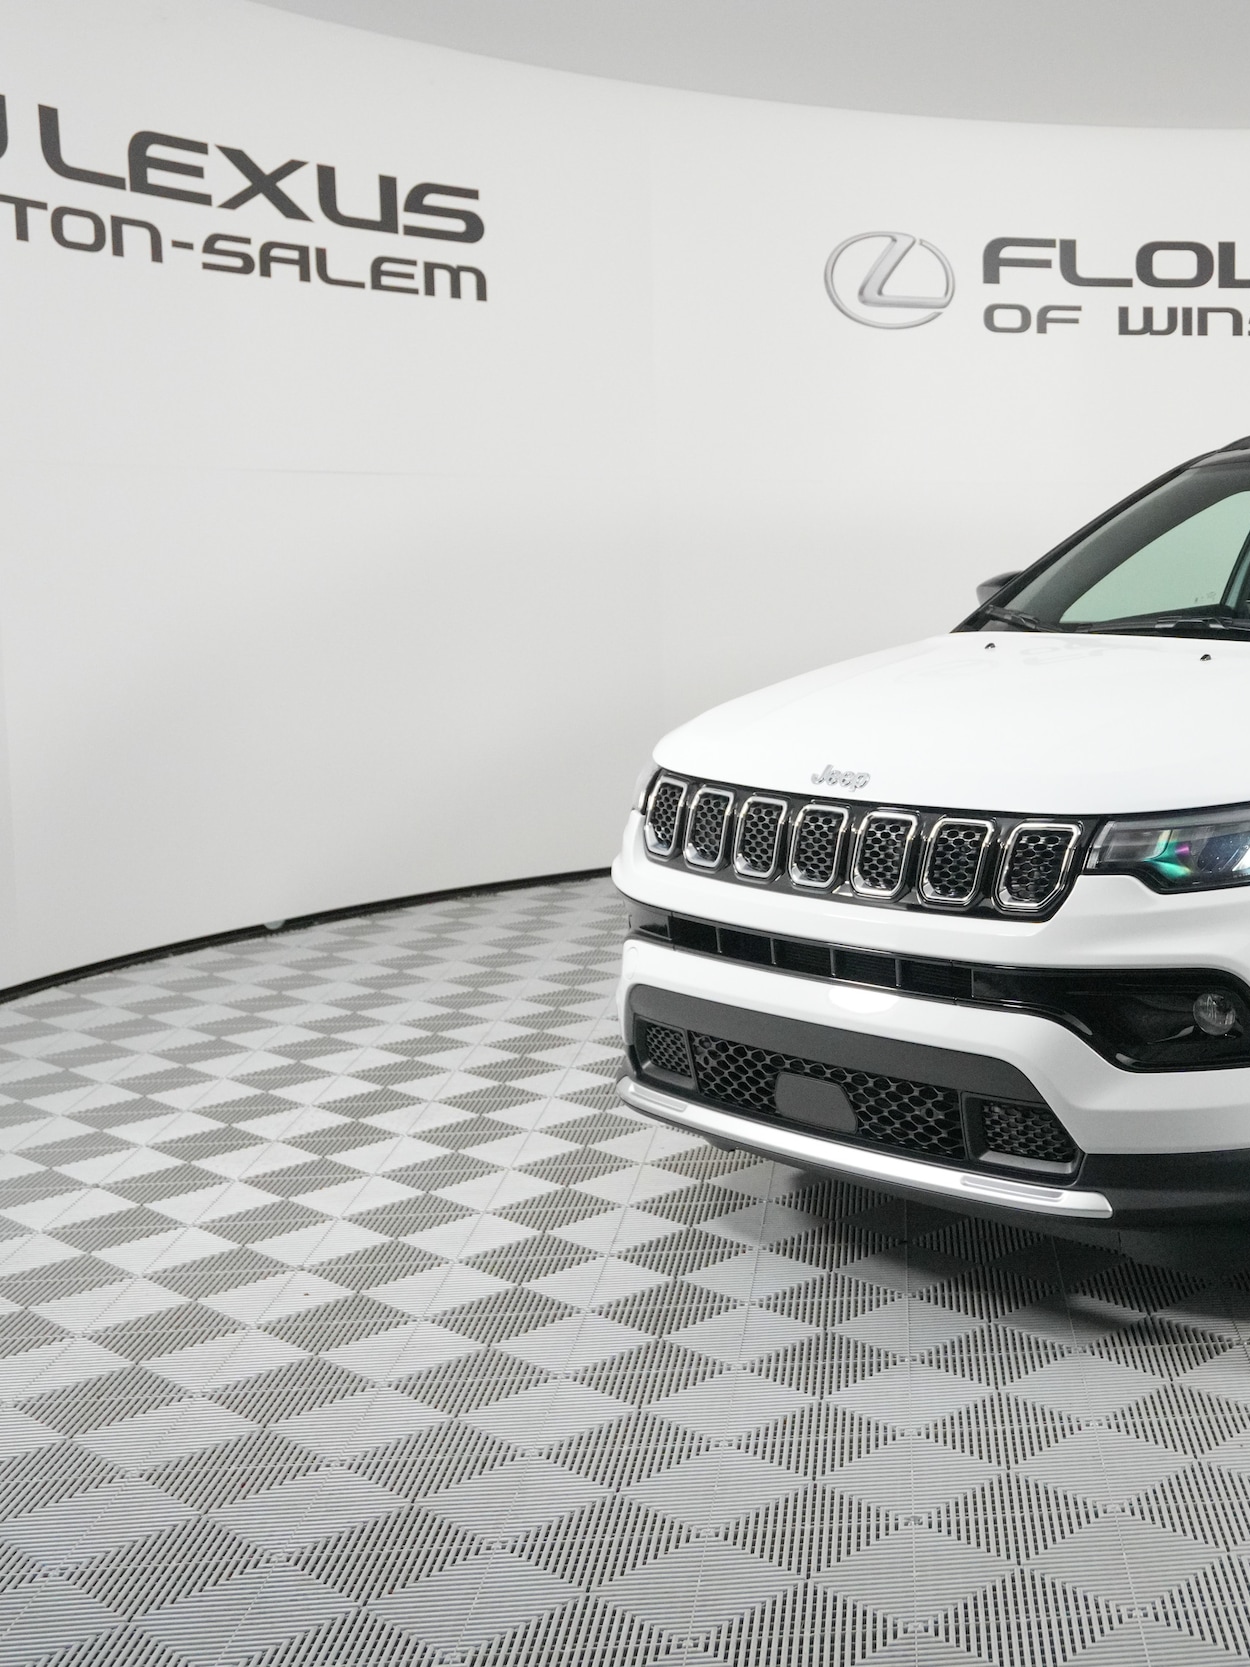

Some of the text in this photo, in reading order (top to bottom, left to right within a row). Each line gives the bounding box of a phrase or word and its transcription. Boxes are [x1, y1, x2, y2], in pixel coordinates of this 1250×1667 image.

[38, 104, 485, 243] LEXUS
[0, 194, 488, 302] TON-SALEM
[984, 305, 1082, 334] OF
[811, 764, 871, 793] Jeep
